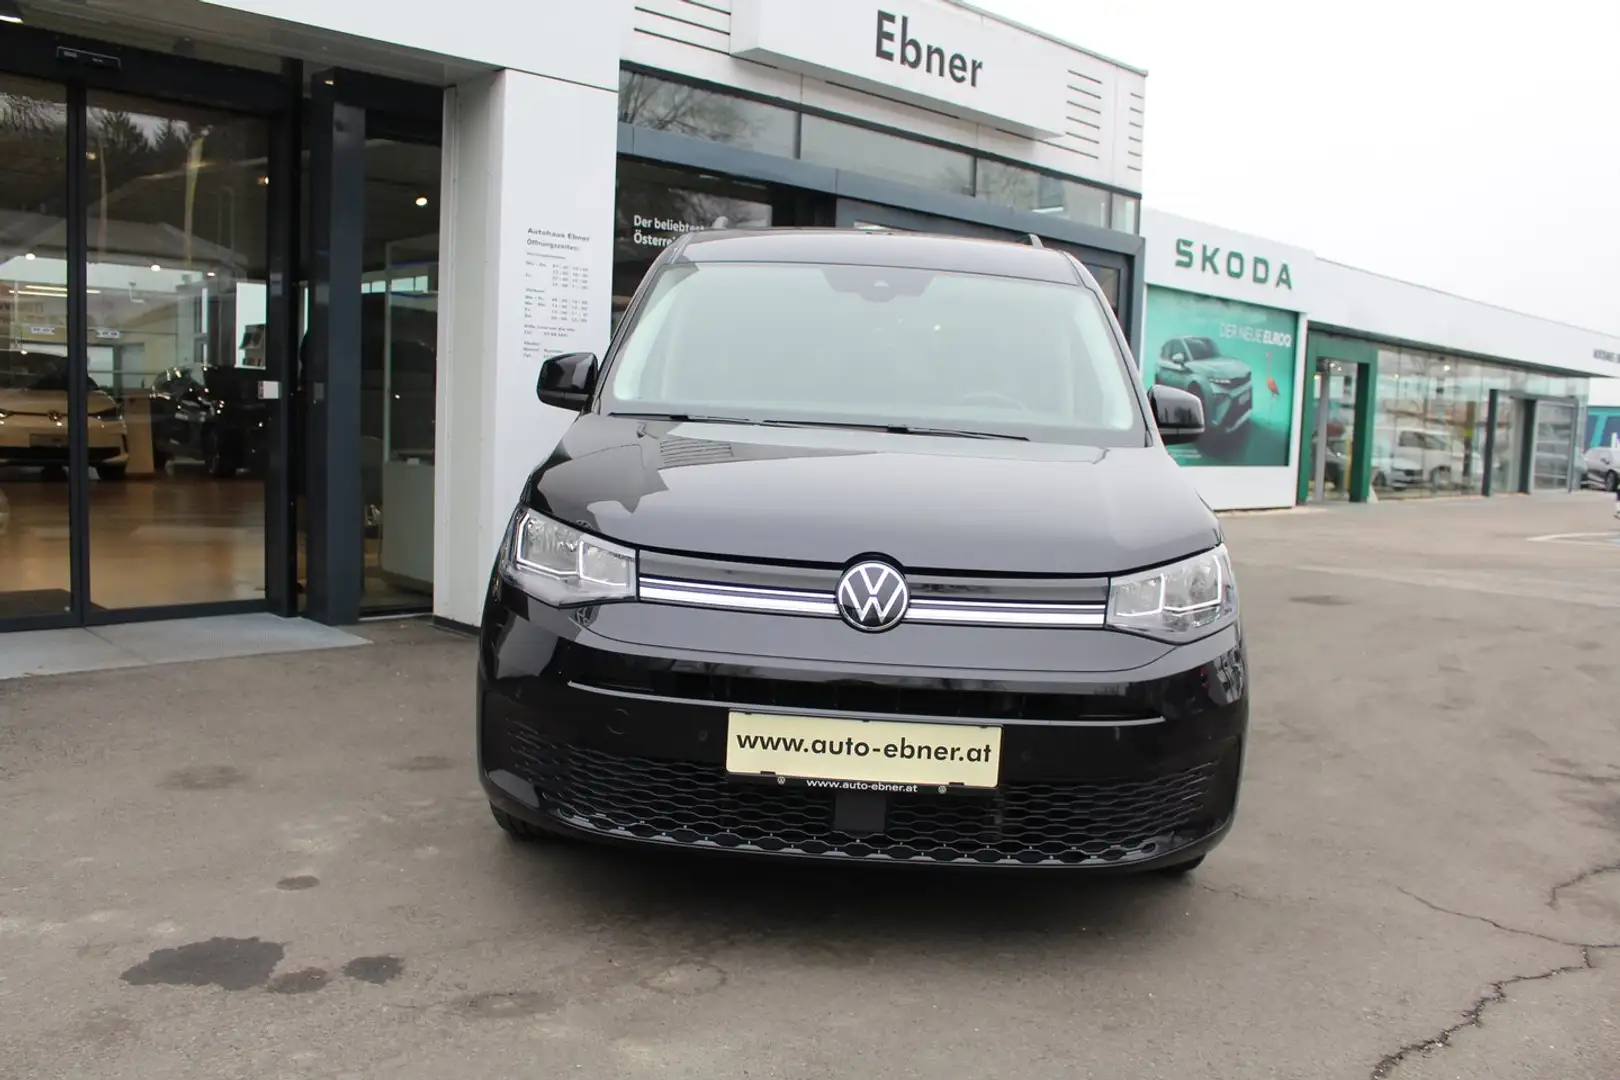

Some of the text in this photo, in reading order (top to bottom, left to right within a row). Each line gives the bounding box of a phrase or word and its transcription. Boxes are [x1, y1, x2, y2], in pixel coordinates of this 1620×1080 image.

[876, 9, 983, 88] Ebner
[633, 214, 652, 228] Der
[527, 227, 590, 242] Autohaus Ebner
[633, 229, 676, 247] Österre
[736, 733, 992, 762] www.auto-ebner.at
[806, 779, 918, 793] www.auto-ebner.at
